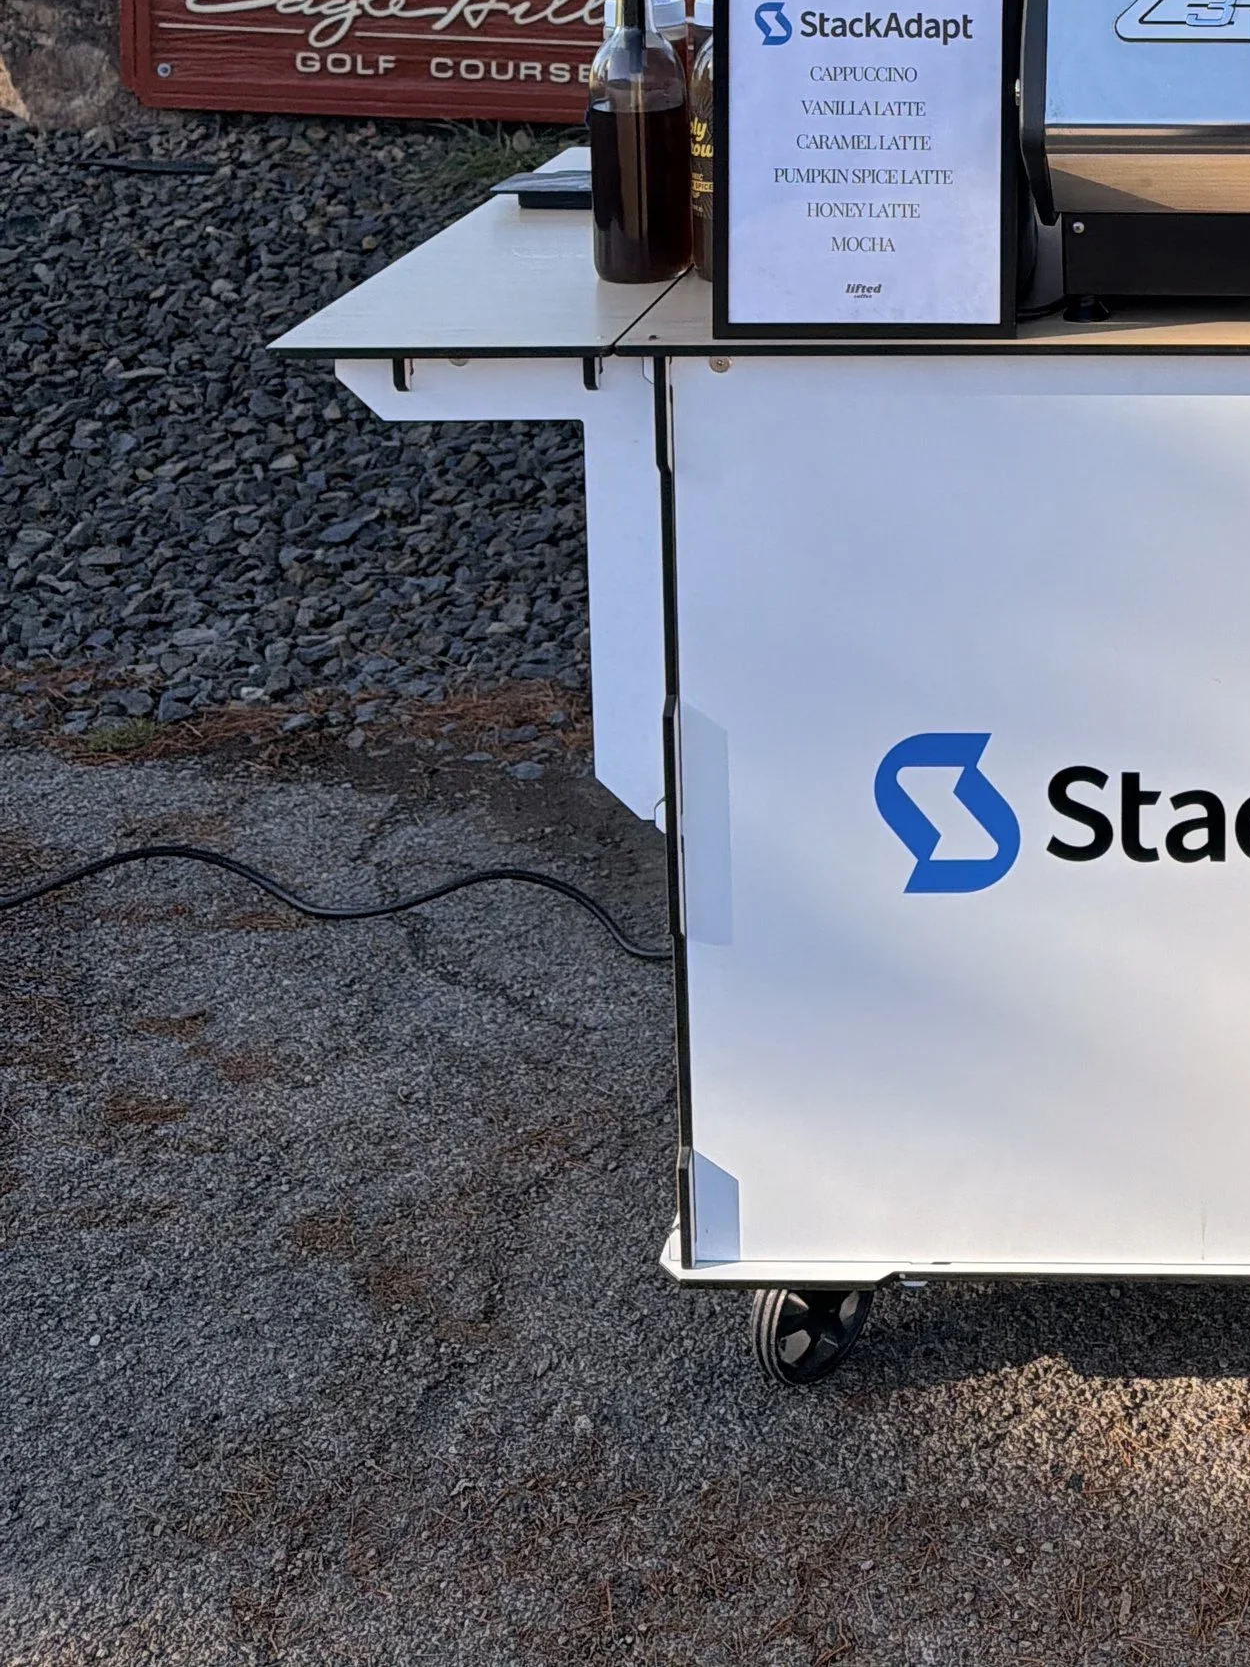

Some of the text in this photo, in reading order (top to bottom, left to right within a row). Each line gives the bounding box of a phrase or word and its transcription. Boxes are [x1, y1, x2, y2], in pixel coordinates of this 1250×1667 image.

[800, 10, 973, 45] StackAdapt
[295, 51, 591, 84] GOLF COURSE
[810, 66, 918, 82] CAPPUCCINO
[801, 100, 926, 117] VANILLA LATTE
[796, 134, 932, 151] CARAMEL LATTE
[774, 167, 953, 185] PUMPKIN SPICE LATTE
[807, 202, 921, 219] HONEY LATTE
[831, 236, 896, 252] MOCHA
[845, 283, 882, 294] lifted
